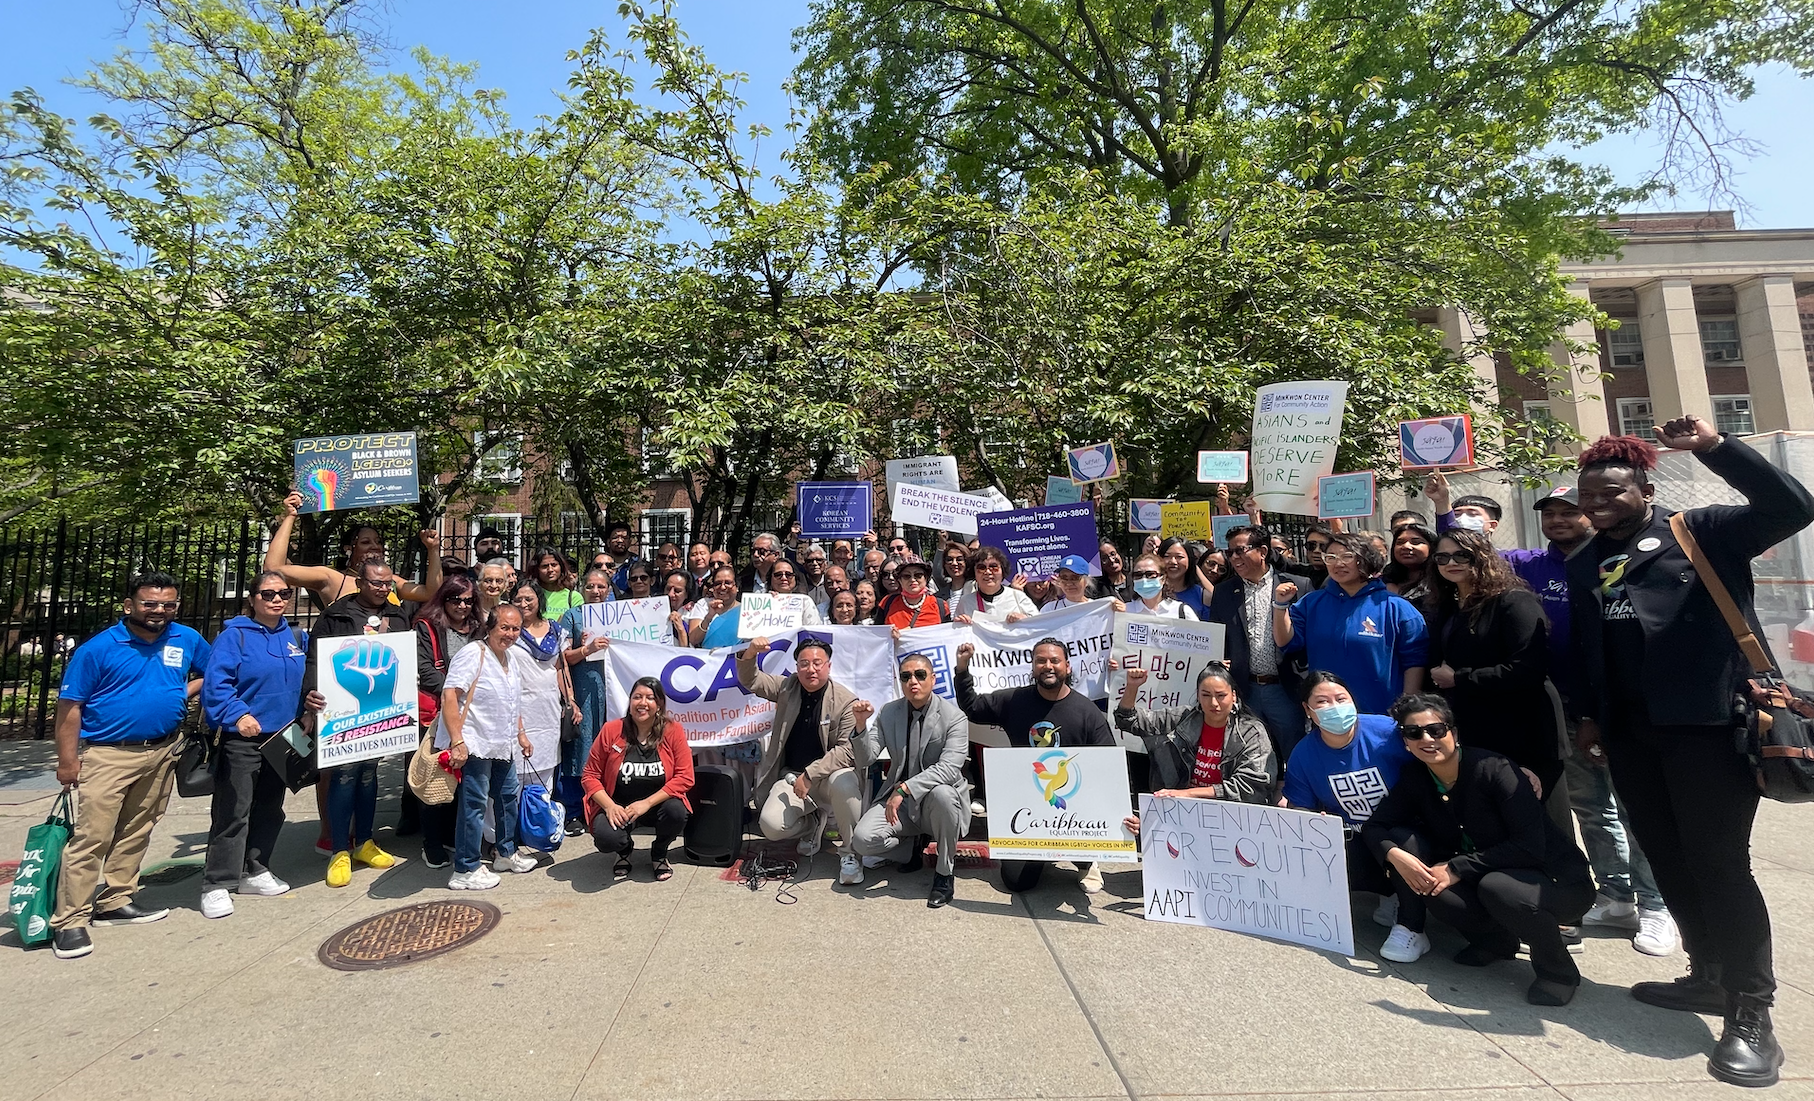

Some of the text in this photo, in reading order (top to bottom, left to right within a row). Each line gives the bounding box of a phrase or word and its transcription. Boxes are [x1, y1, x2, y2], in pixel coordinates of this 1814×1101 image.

[1315, 417, 1331, 425] and
[296, 435, 414, 453] PROTECT
[351, 458, 413, 470] LGBTQ+
[352, 449, 412, 460] BLACK & BROWN
[352, 468, 412, 480] ASYLUM SEEKERS
[903, 461, 942, 469] IMMIGRANT
[901, 487, 988, 509] BREAK THE SILENCE
[901, 497, 985, 517] END THE VIOLENC
[980, 518, 1008, 527] 24-Hour
[1038, 508, 1090, 520] 718-460-3800
[1016, 522, 1055, 532] KAFSC.org
[1004, 534, 1070, 547] Transforming Lives.
[743, 597, 771, 610] INDIA
[584, 601, 637, 628] INDIA
[611, 624, 659, 642] HOME
[332, 704, 408, 731] OUR EXISTENCE
[667, 701, 771, 724] Coalition For Asian
[332, 716, 409, 745] IS RESISTANCE
[322, 744, 353, 758] TRANS
[354, 738, 379, 753] LIVES
[379, 733, 416, 746] MATTER!
[1010, 807, 1109, 835] Caribbean
[1143, 798, 1332, 850] ARMENIANS
[1049, 829, 1079, 837] EQUALITY
[1151, 830, 1337, 884] FOR EQUITY
[1183, 870, 1279, 900] INVEST IN
[1148, 889, 1341, 945] AAPI COMMUNITIES!
